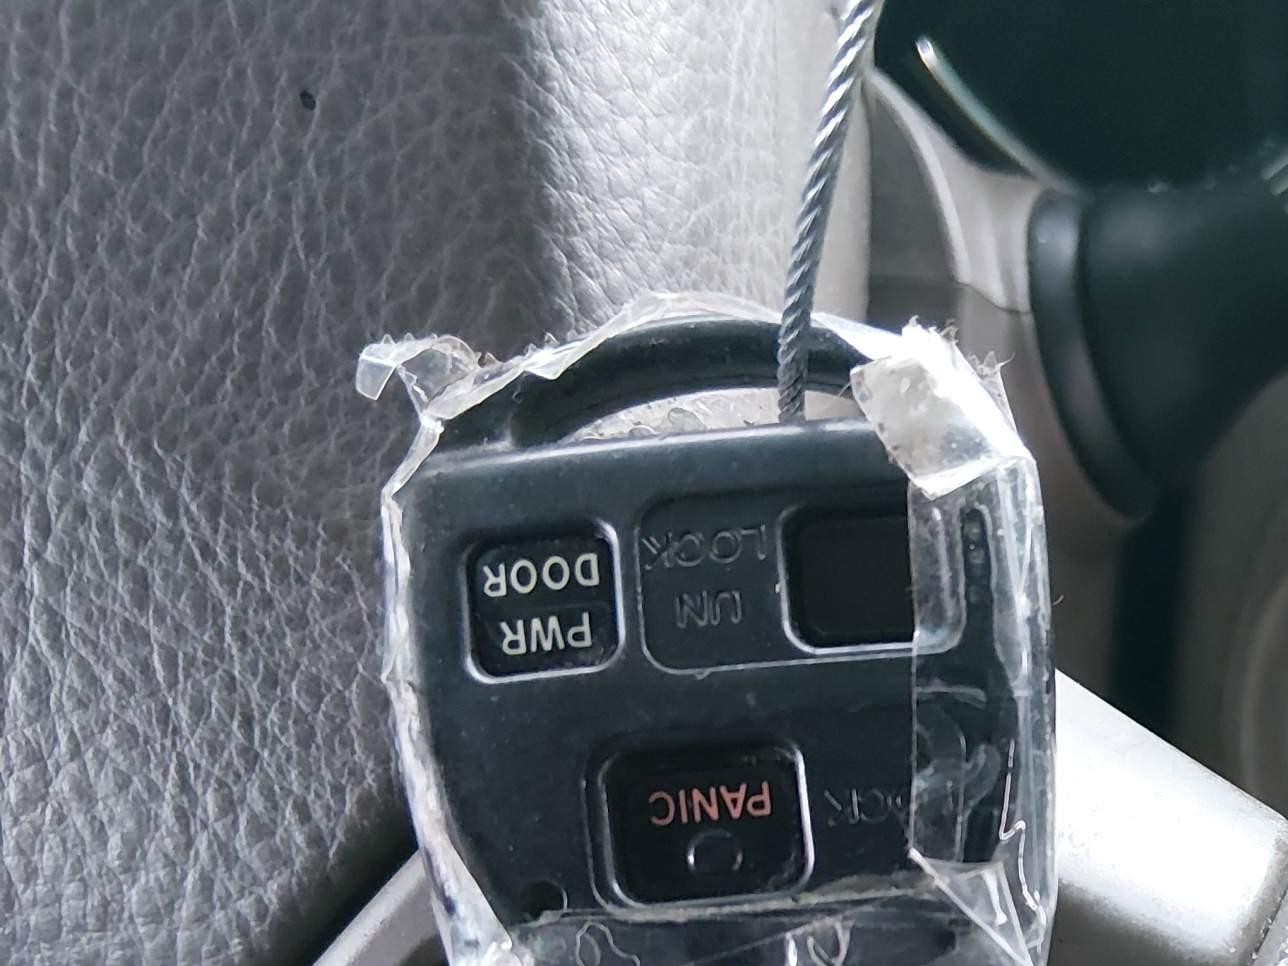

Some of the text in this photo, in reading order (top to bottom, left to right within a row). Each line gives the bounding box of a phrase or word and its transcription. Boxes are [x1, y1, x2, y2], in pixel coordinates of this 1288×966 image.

[641, 524, 766, 571] LOCK
[482, 552, 600, 598] DOOR
[676, 590, 742, 629] UN
[501, 611, 593, 655] PWR
[649, 780, 773, 825] PANIC
